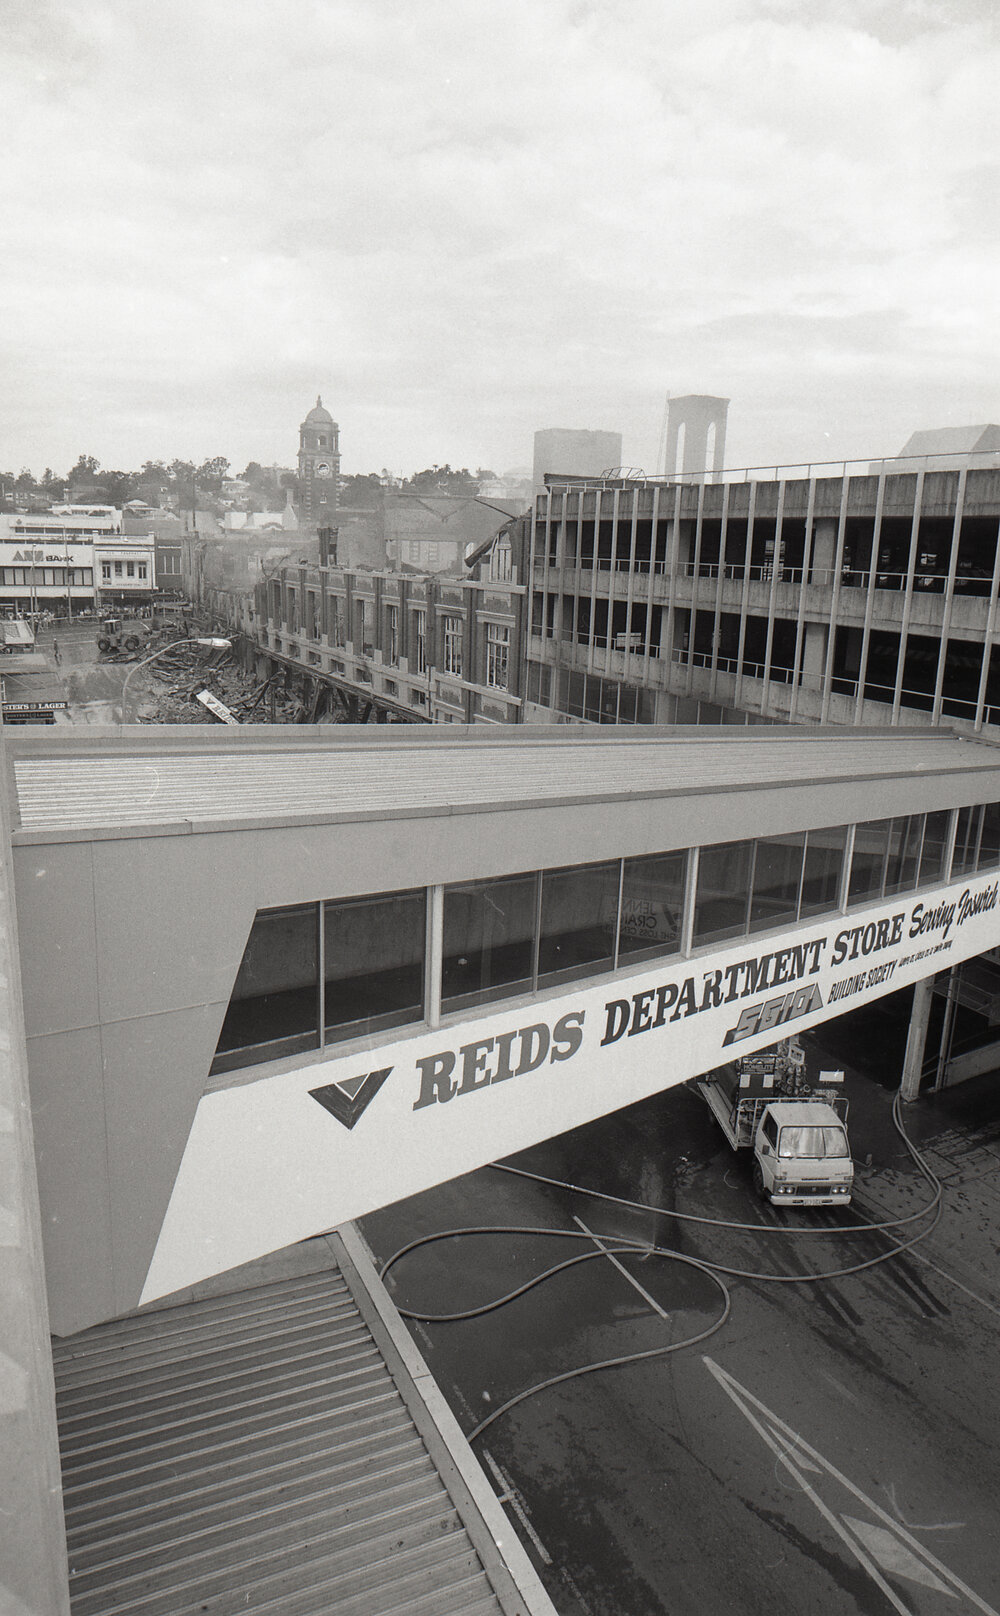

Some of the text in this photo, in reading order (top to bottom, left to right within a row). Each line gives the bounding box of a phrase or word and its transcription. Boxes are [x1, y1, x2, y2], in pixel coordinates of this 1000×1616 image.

[45, 555, 74, 563] BANK
[412, 1009, 586, 1111] REIDS
[600, 937, 827, 1047] DEPARTMENT
[830, 912, 905, 967] STORE
[909, 900, 956, 940] Serving
[956, 880, 999, 926] Ipswich
[827, 972, 867, 1005] BUILDING
[865, 958, 898, 989] SOCIETY
